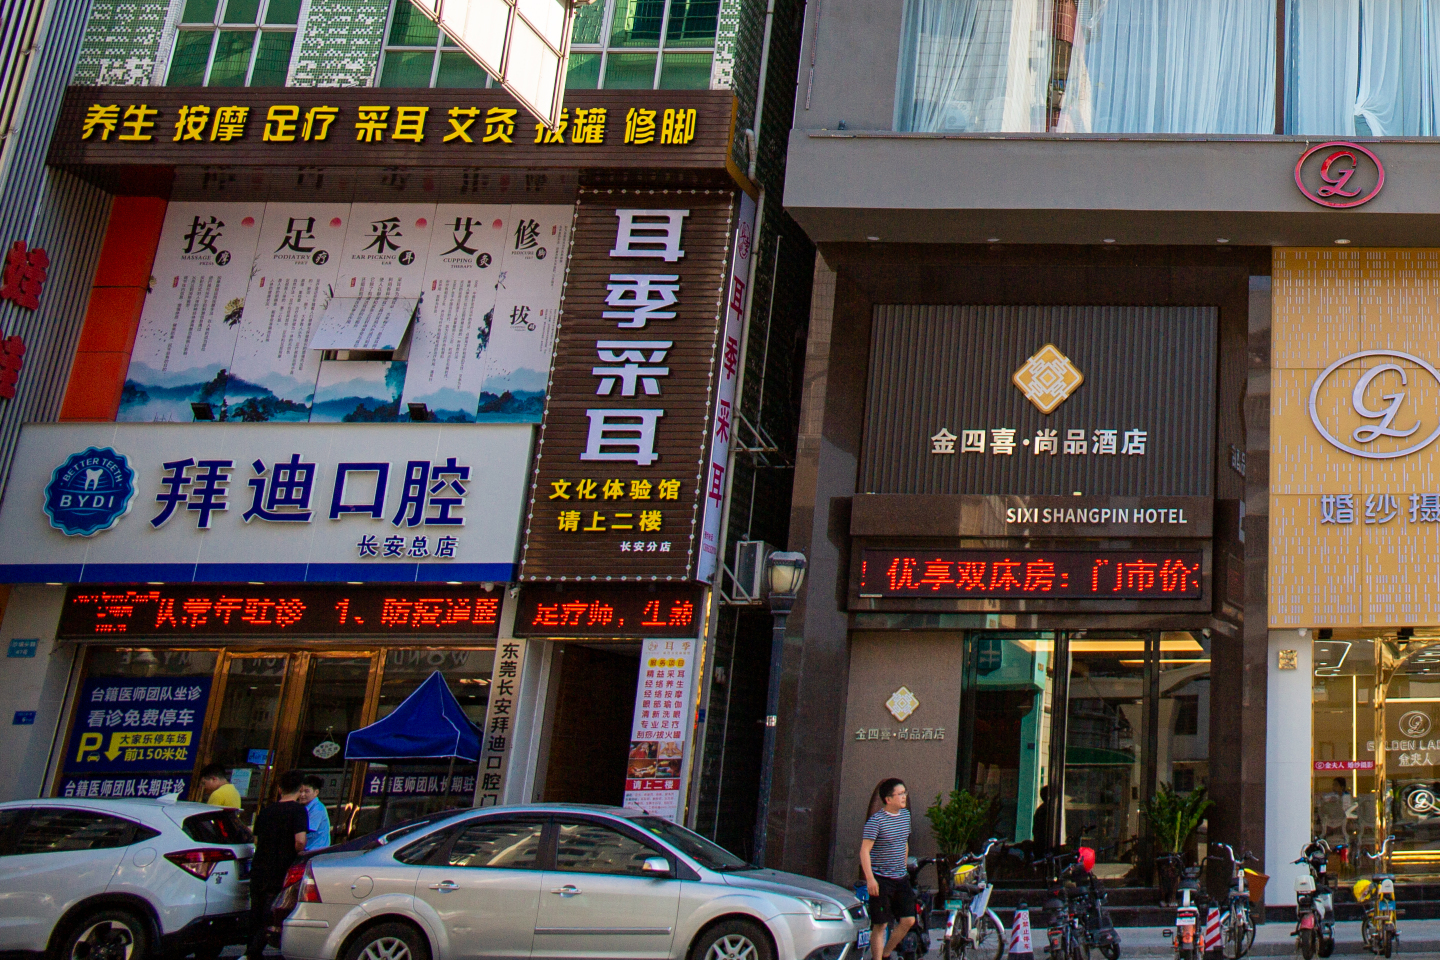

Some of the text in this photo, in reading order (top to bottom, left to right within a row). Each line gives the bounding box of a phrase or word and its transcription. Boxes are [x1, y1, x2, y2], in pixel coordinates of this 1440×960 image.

[81, 104, 158, 141] 养生
[173, 105, 250, 141] 按摩
[262, 105, 339, 141] 足疗
[355, 105, 430, 143] 采耳
[443, 106, 518, 144] 艾灸
[623, 107, 698, 145] 修脚
[182, 215, 226, 255] 按
[273, 216, 317, 254] 足
[361, 216, 403, 254] 采
[439, 216, 483, 257] 艾
[513, 218, 542, 251] 修
[509, 304, 532, 326] 拔
[579, 208, 691, 467] 耳季采耳
[930, 427, 1148, 456] 金四喜·尚品酒店
[62, 457, 123, 483] BETTER TEETH
[60, 494, 116, 508] BYDI
[149, 452, 473, 530] 拜迪口腔
[548, 478, 682, 501] 文化体验馆
[557, 509, 663, 533] 请上二楼
[1006, 507, 1188, 524] SIXI SHANGPIN HOTEL
[356, 534, 460, 559] 长安总店
[619, 540, 672, 553] 长安分店
[87, 709, 196, 728] 看诊免费停车
[124, 748, 188, 762] 前150米处
[1367, 739, 1415, 752] GLDEN
[1398, 752, 1434, 766] 金夫人
